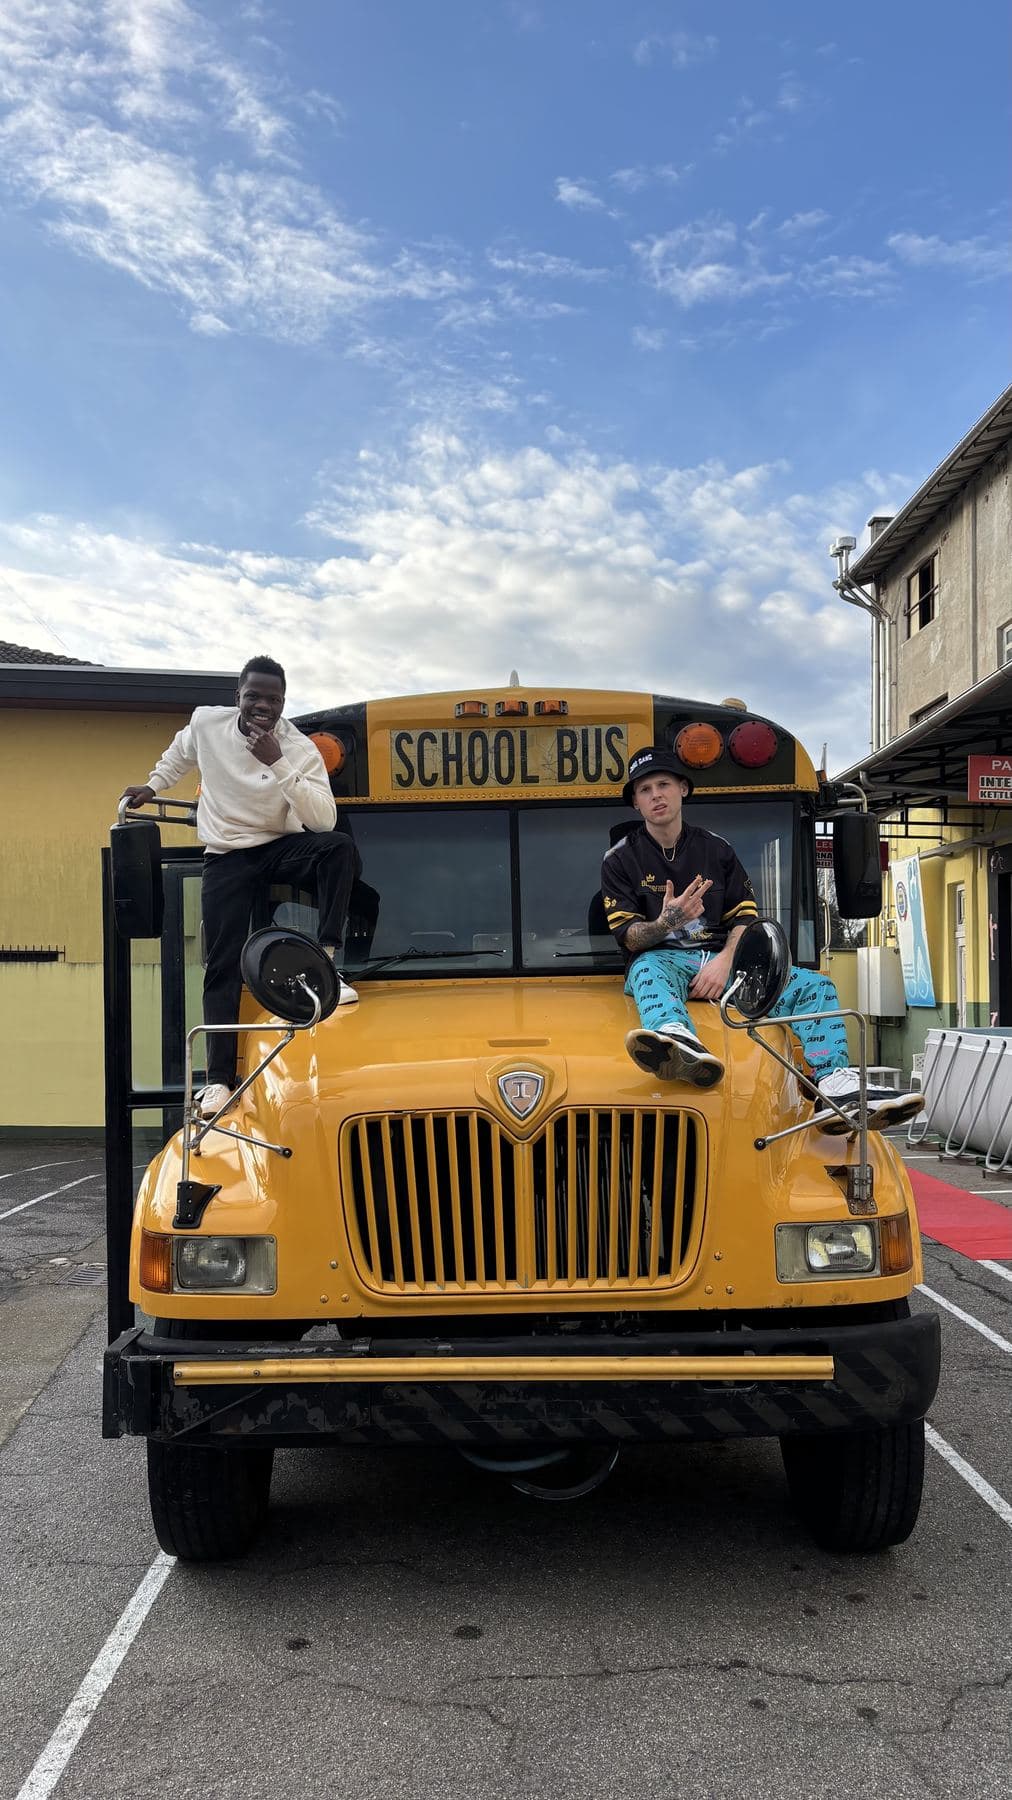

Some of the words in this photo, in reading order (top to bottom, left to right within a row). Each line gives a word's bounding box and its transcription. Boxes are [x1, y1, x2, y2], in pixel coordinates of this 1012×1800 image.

[394, 729, 539, 788] SCHOOL
[556, 726, 624, 783] BUS
[992, 760, 1012, 771] PA
[980, 777, 1012, 788] INTE
